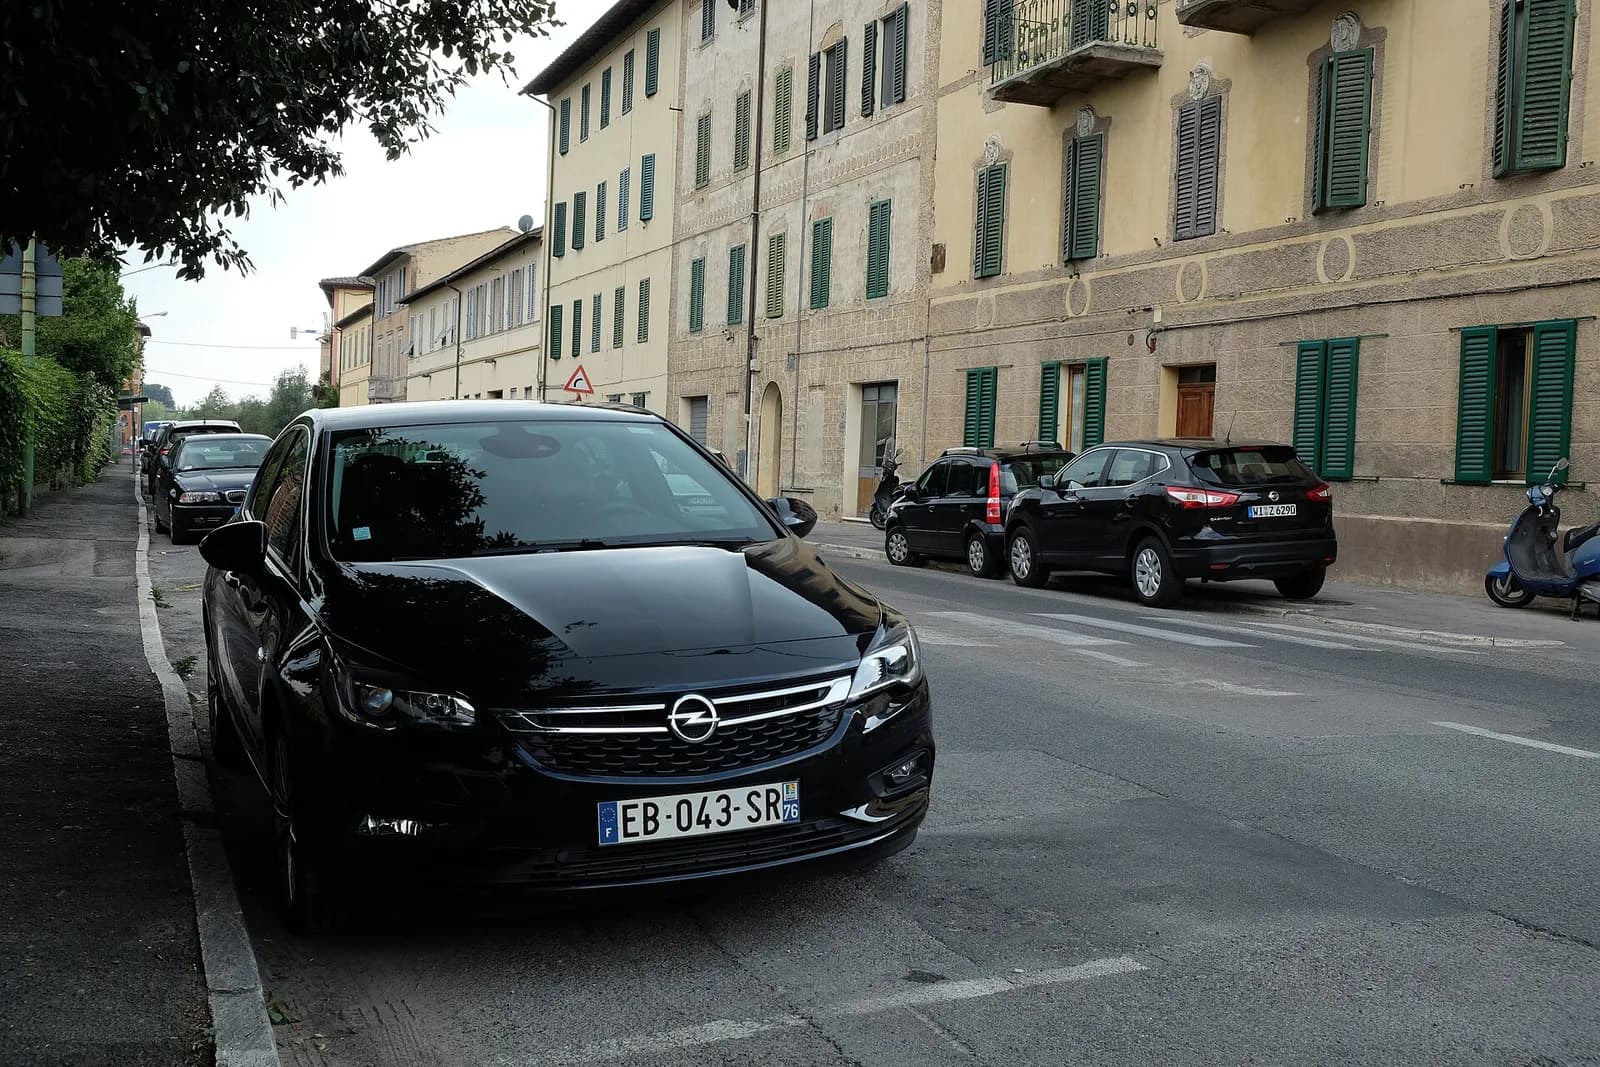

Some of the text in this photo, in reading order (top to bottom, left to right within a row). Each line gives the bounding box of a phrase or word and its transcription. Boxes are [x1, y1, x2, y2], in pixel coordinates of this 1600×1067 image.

[622, 788, 781, 838] EB-043-SR
[783, 803, 799, 820] 76
[605, 828, 612, 838] F
